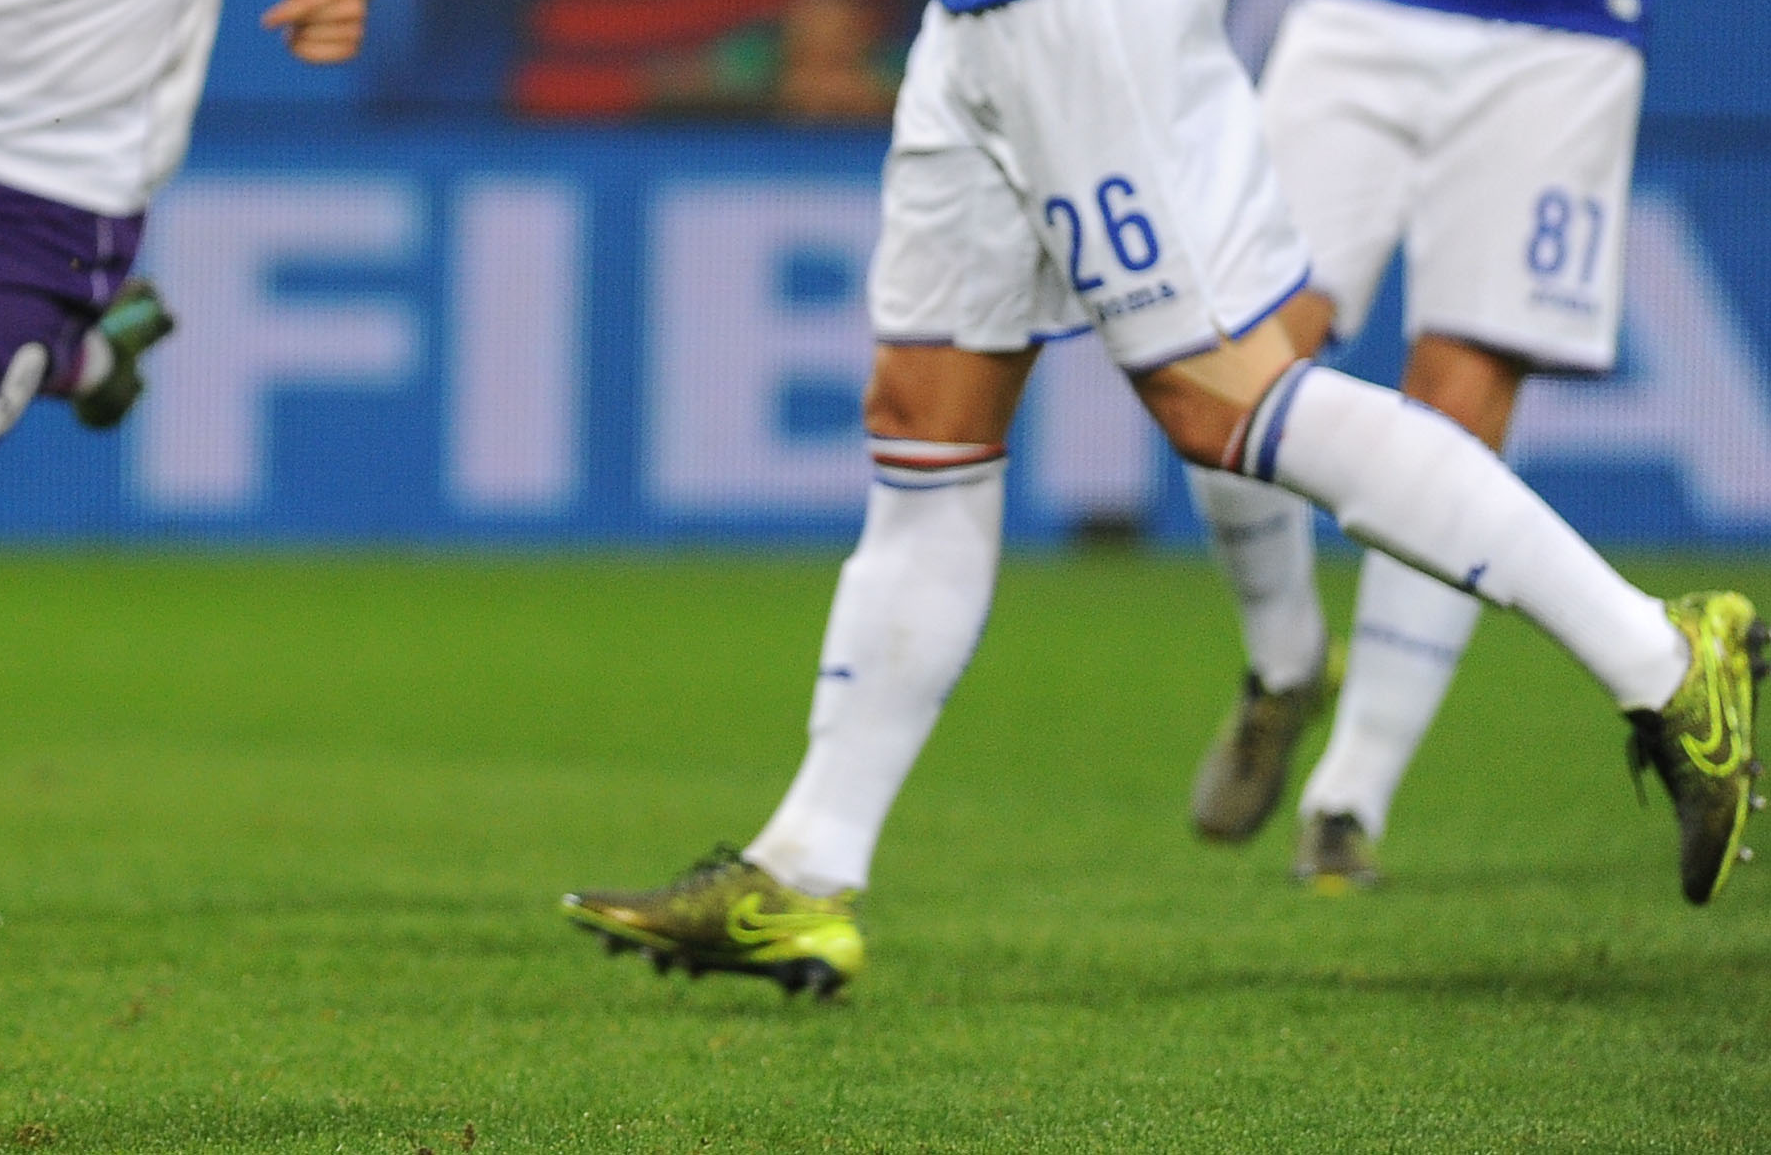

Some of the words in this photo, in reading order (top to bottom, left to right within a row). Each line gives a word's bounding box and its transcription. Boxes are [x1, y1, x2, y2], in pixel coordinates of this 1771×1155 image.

[1044, 176, 1160, 294] 26
[1525, 187, 1605, 284] 81
[133, 180, 1771, 519] FIBA
